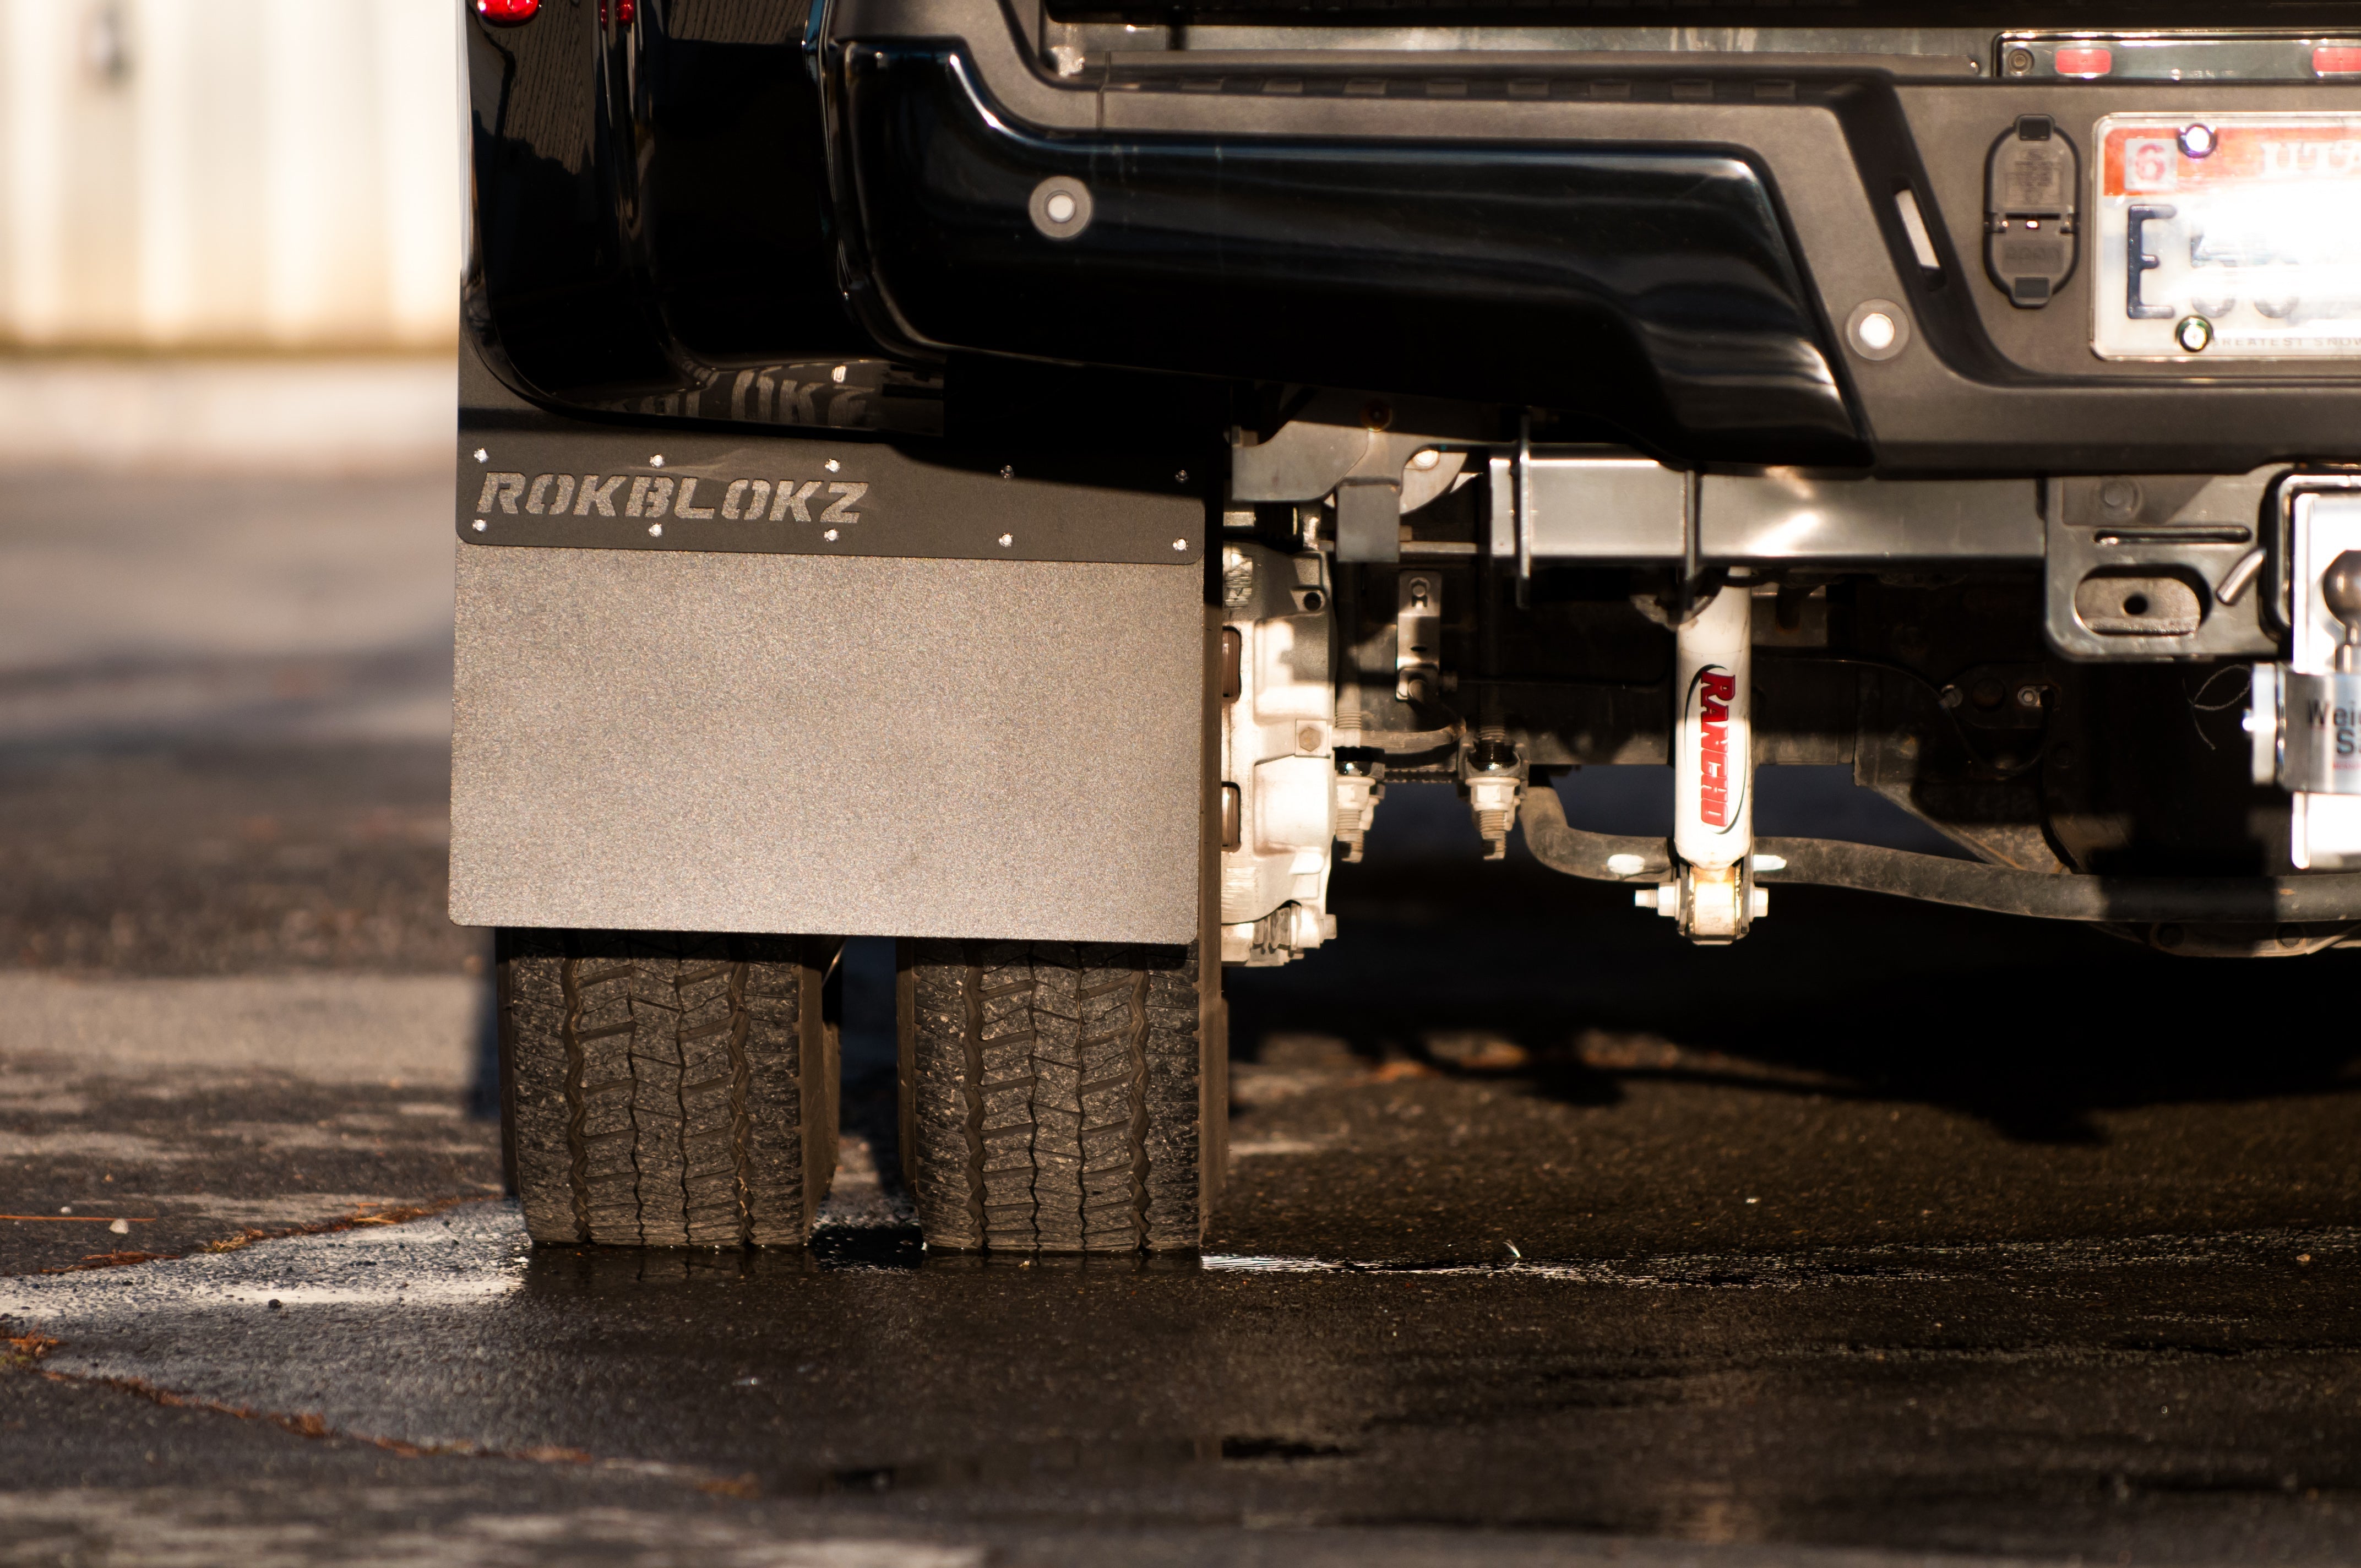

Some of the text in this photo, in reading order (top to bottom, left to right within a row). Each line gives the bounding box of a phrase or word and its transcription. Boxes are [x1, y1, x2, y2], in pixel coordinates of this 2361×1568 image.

[2135, 143, 2166, 182] 6
[476, 472, 869, 524] ROKBLOKZ
[2307, 699, 2361, 727] Wei
[1701, 671, 1736, 827] RANCHO
[2336, 729, 2361, 755] S
